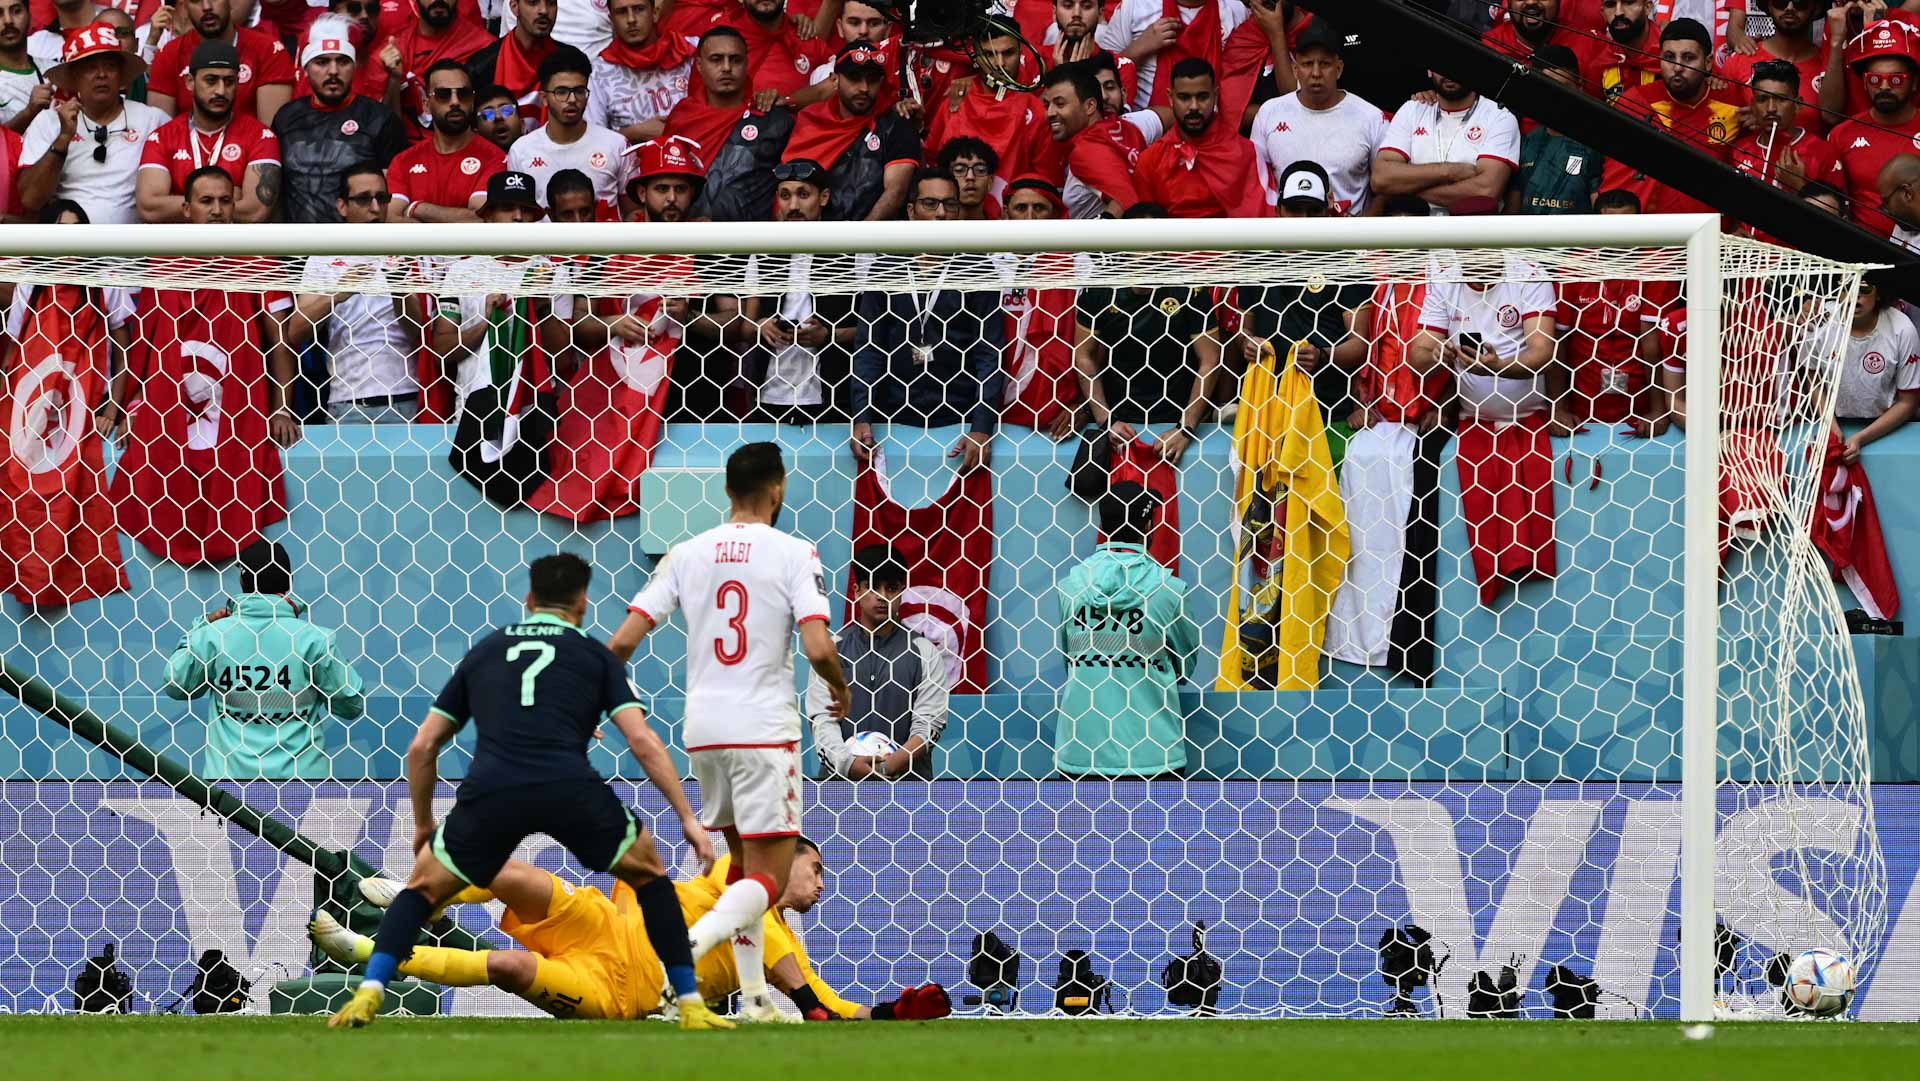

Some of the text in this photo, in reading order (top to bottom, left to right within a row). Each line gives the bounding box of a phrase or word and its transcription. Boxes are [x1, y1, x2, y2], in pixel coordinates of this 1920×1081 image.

[646, 86, 672, 113] 10
[506, 174, 524, 186] ck
[715, 541, 752, 563] TALBI
[505, 625, 565, 636] LECKIE
[714, 579, 749, 666] 3
[1073, 605, 1145, 635] 4578
[219, 664, 292, 692] 4524
[506, 640, 556, 707] 7
[1322, 798, 1920, 1020] VIS
